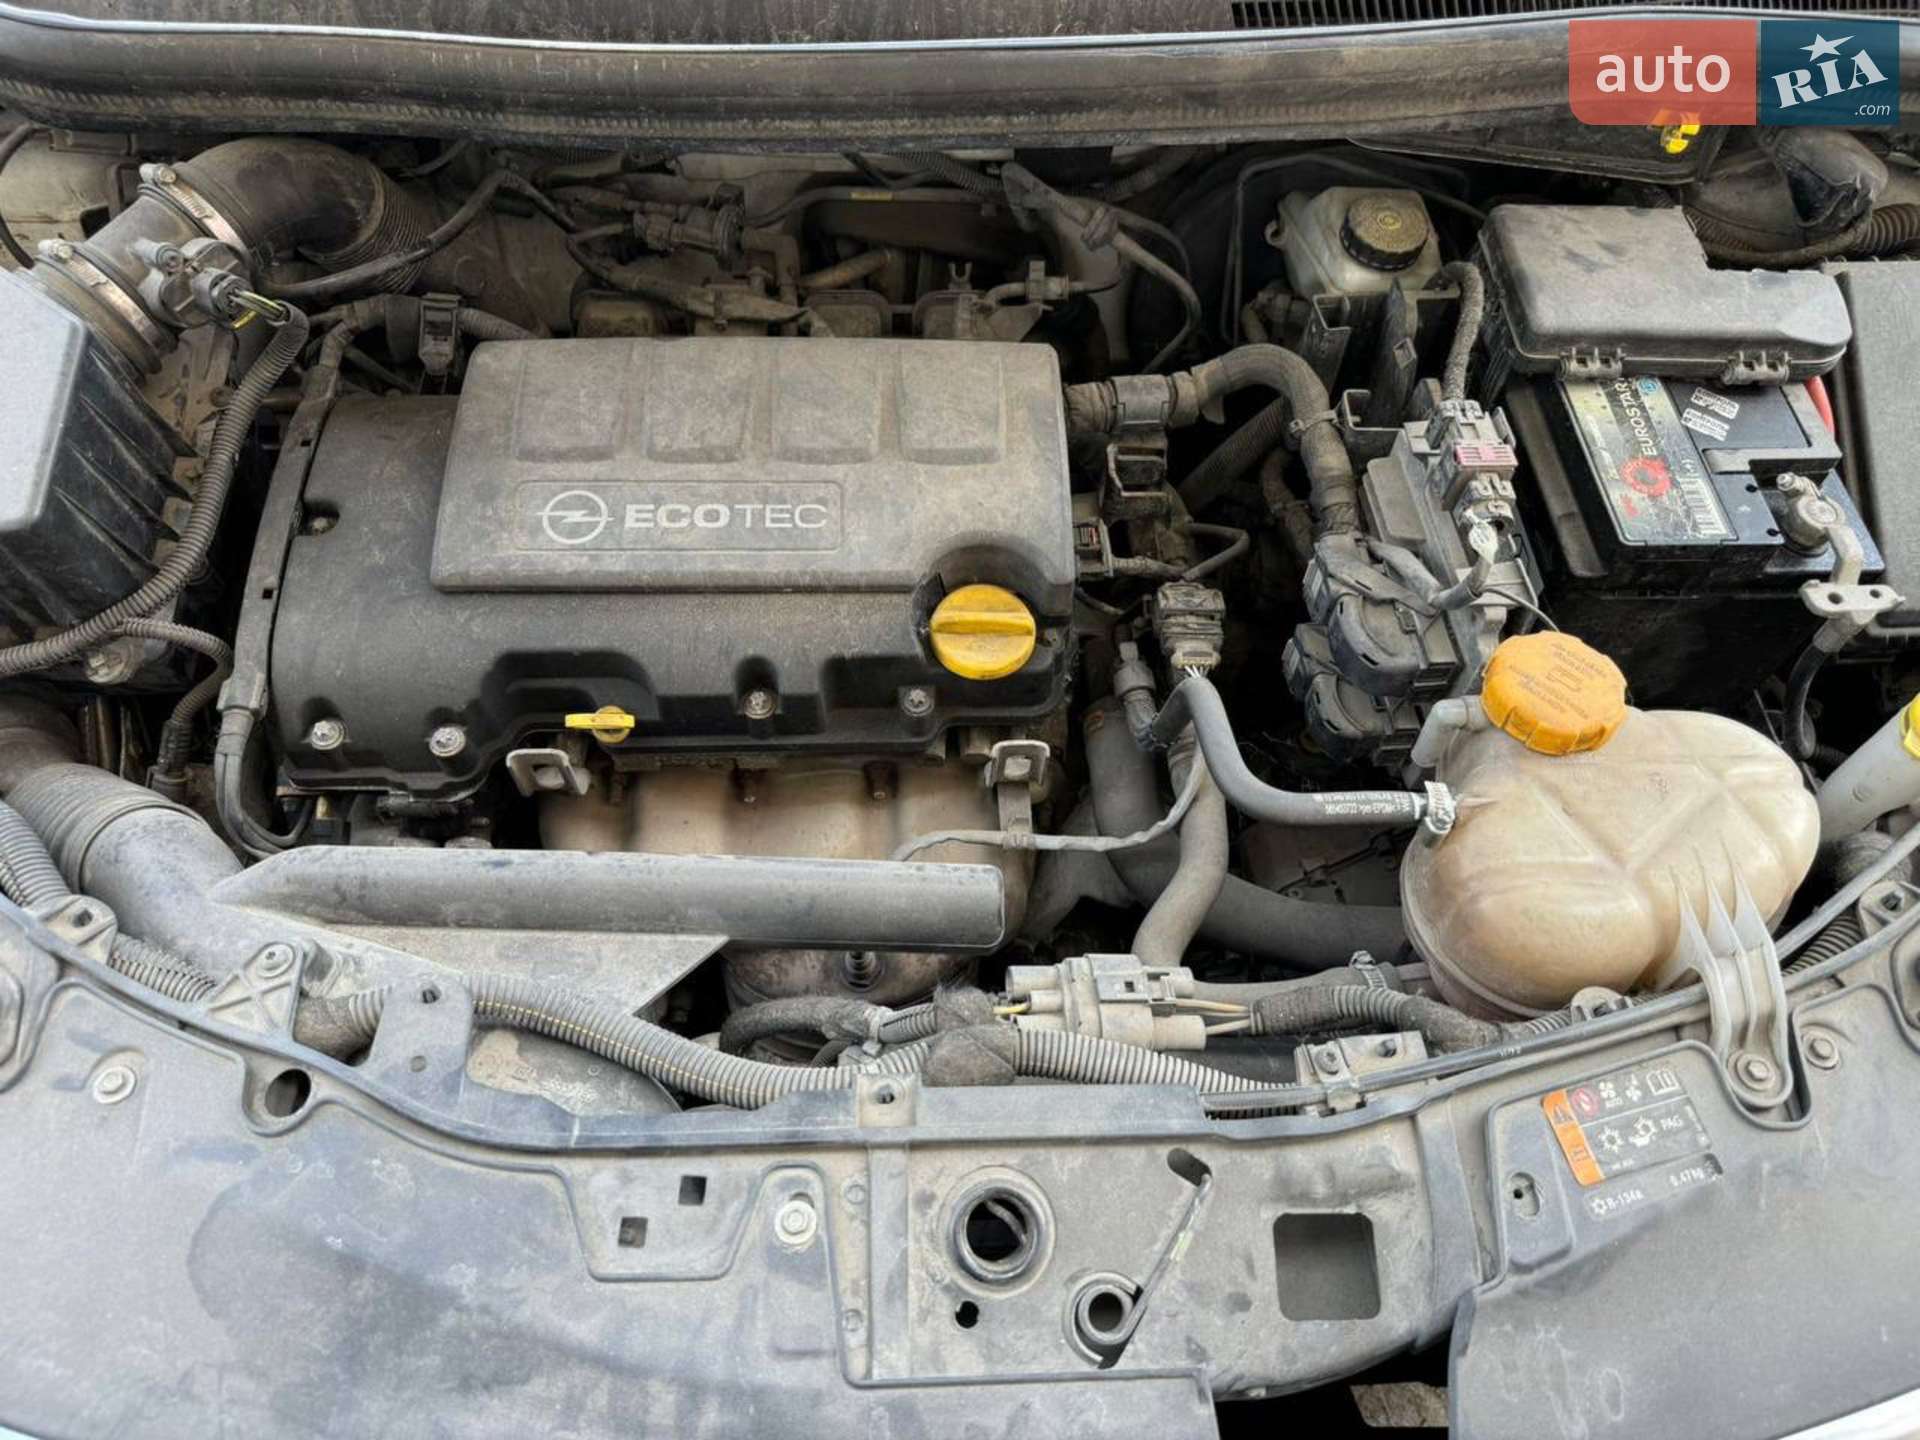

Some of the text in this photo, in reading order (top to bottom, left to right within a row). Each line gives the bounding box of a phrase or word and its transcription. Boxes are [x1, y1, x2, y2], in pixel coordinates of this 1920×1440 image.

[1614, 377, 1658, 457] EUROSTAR
[624, 503, 828, 529] ECOTEC
[1660, 1115, 1684, 1131] PAG
